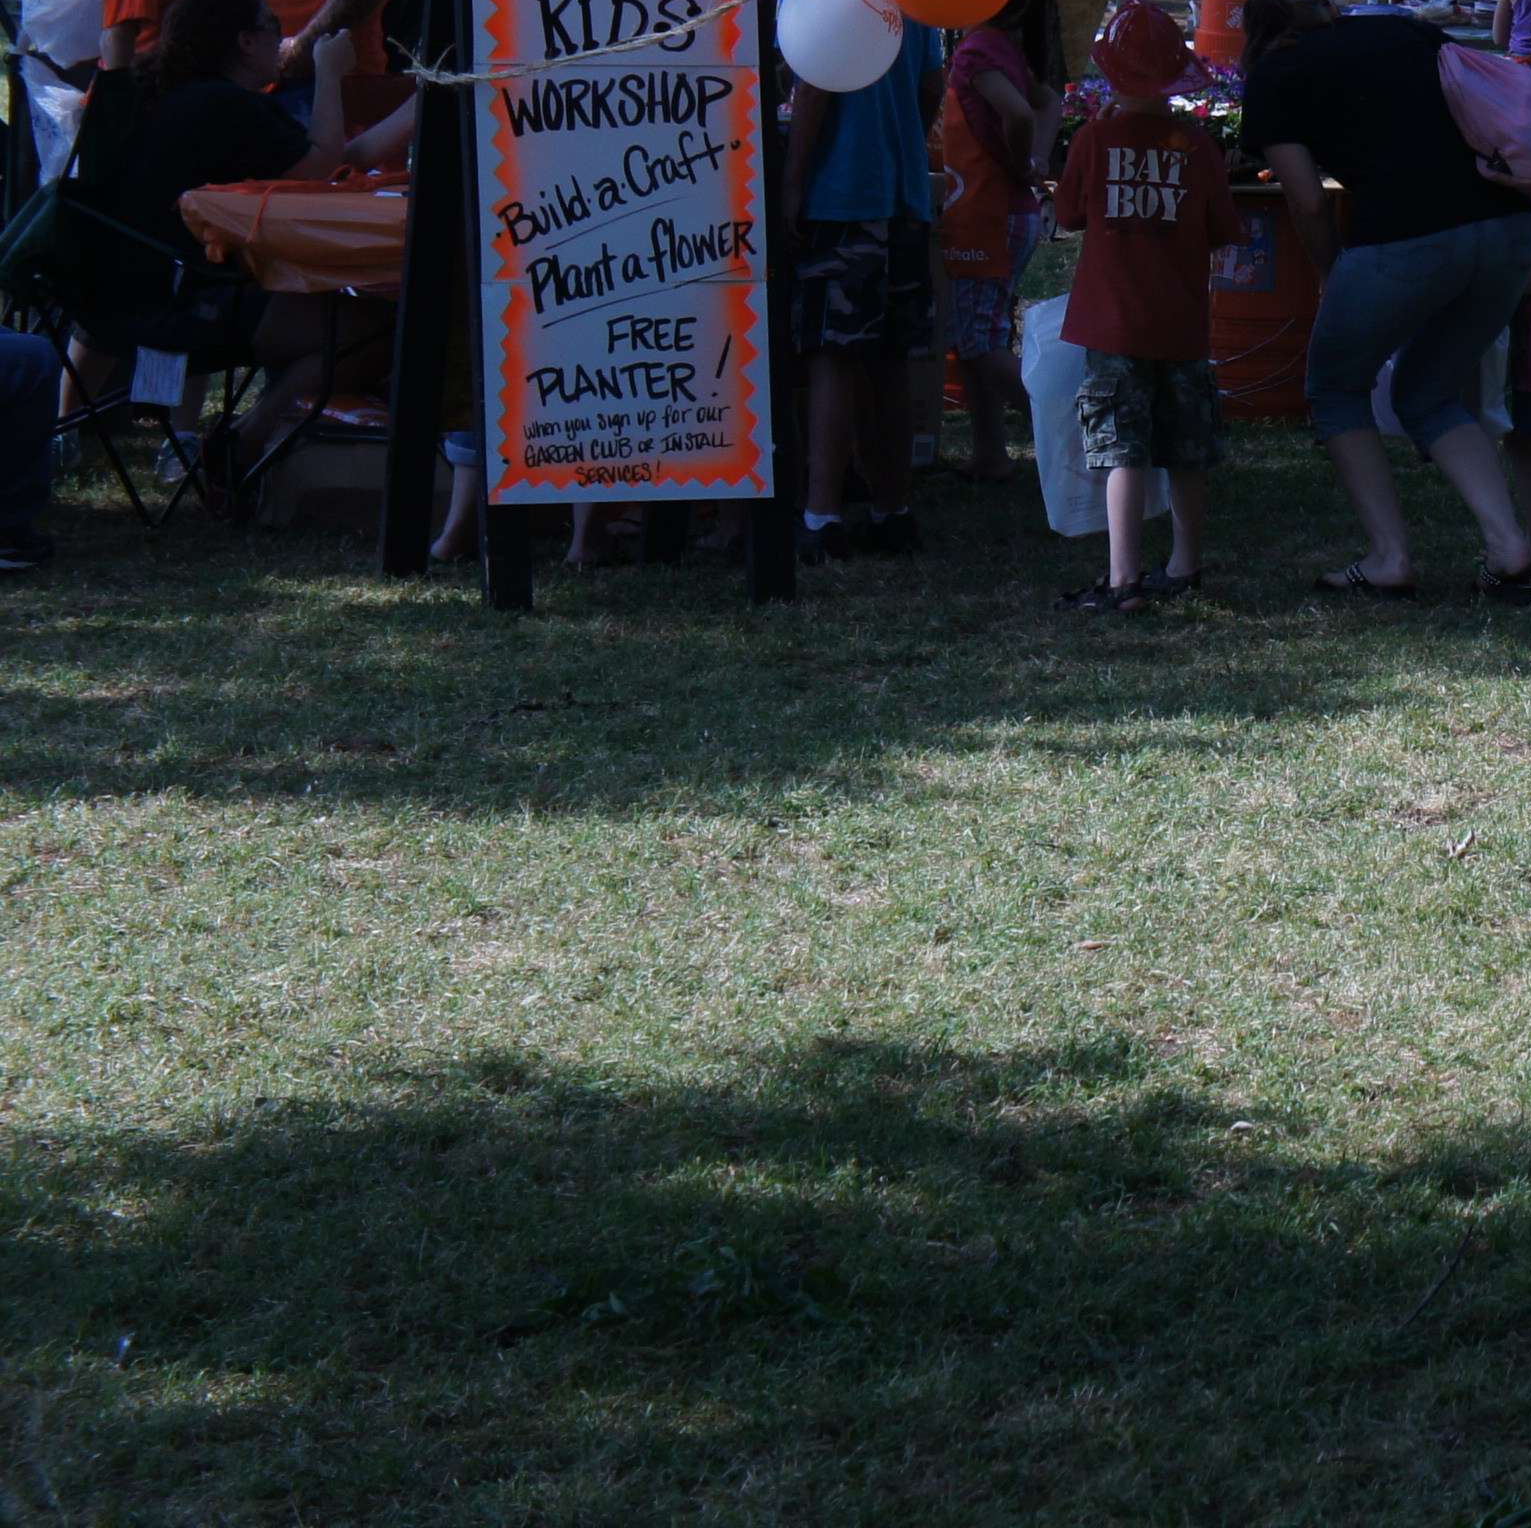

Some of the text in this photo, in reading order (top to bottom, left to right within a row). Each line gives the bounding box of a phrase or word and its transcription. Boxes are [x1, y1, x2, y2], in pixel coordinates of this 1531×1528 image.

[502, 70, 733, 138] WORKSHOP
[1106, 146, 1188, 186] BAT
[1103, 183, 1189, 222] BOY
[525, 243, 617, 314] Plant
[622, 252, 649, 284] a
[607, 314, 697, 354] FREE
[564, 419, 592, 442] you
[636, 410, 656, 428] up
[662, 407, 693, 428] for
[696, 406, 731, 423] our
[524, 439, 584, 468] GARDEN
[590, 437, 633, 462] CLUB
[660, 432, 734, 455] INSTALL
